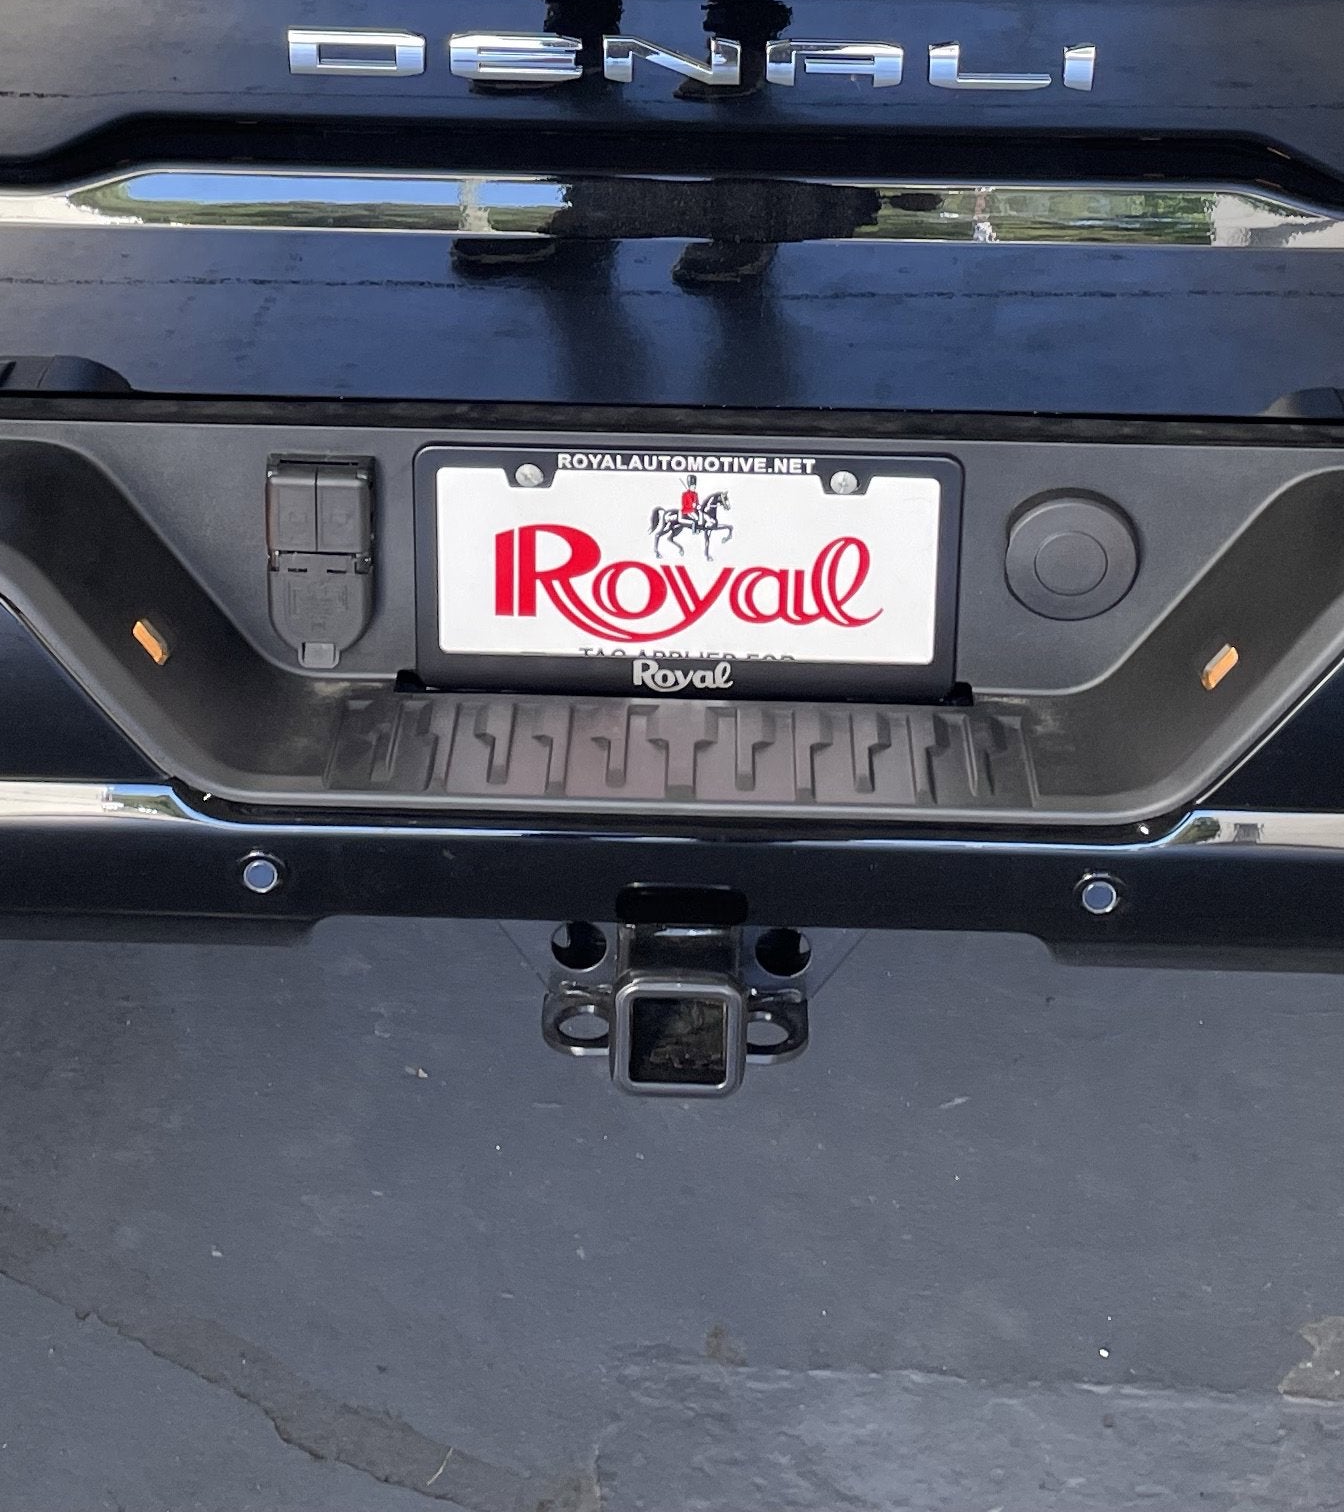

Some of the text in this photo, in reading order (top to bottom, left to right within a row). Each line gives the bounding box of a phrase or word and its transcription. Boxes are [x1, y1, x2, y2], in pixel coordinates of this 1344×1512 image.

[287, 28, 1096, 92] DENALI
[556, 453, 817, 475] ROYALAUTOMOTIVE.NET
[494, 523, 884, 643] Royal
[632, 658, 734, 693] Royal
